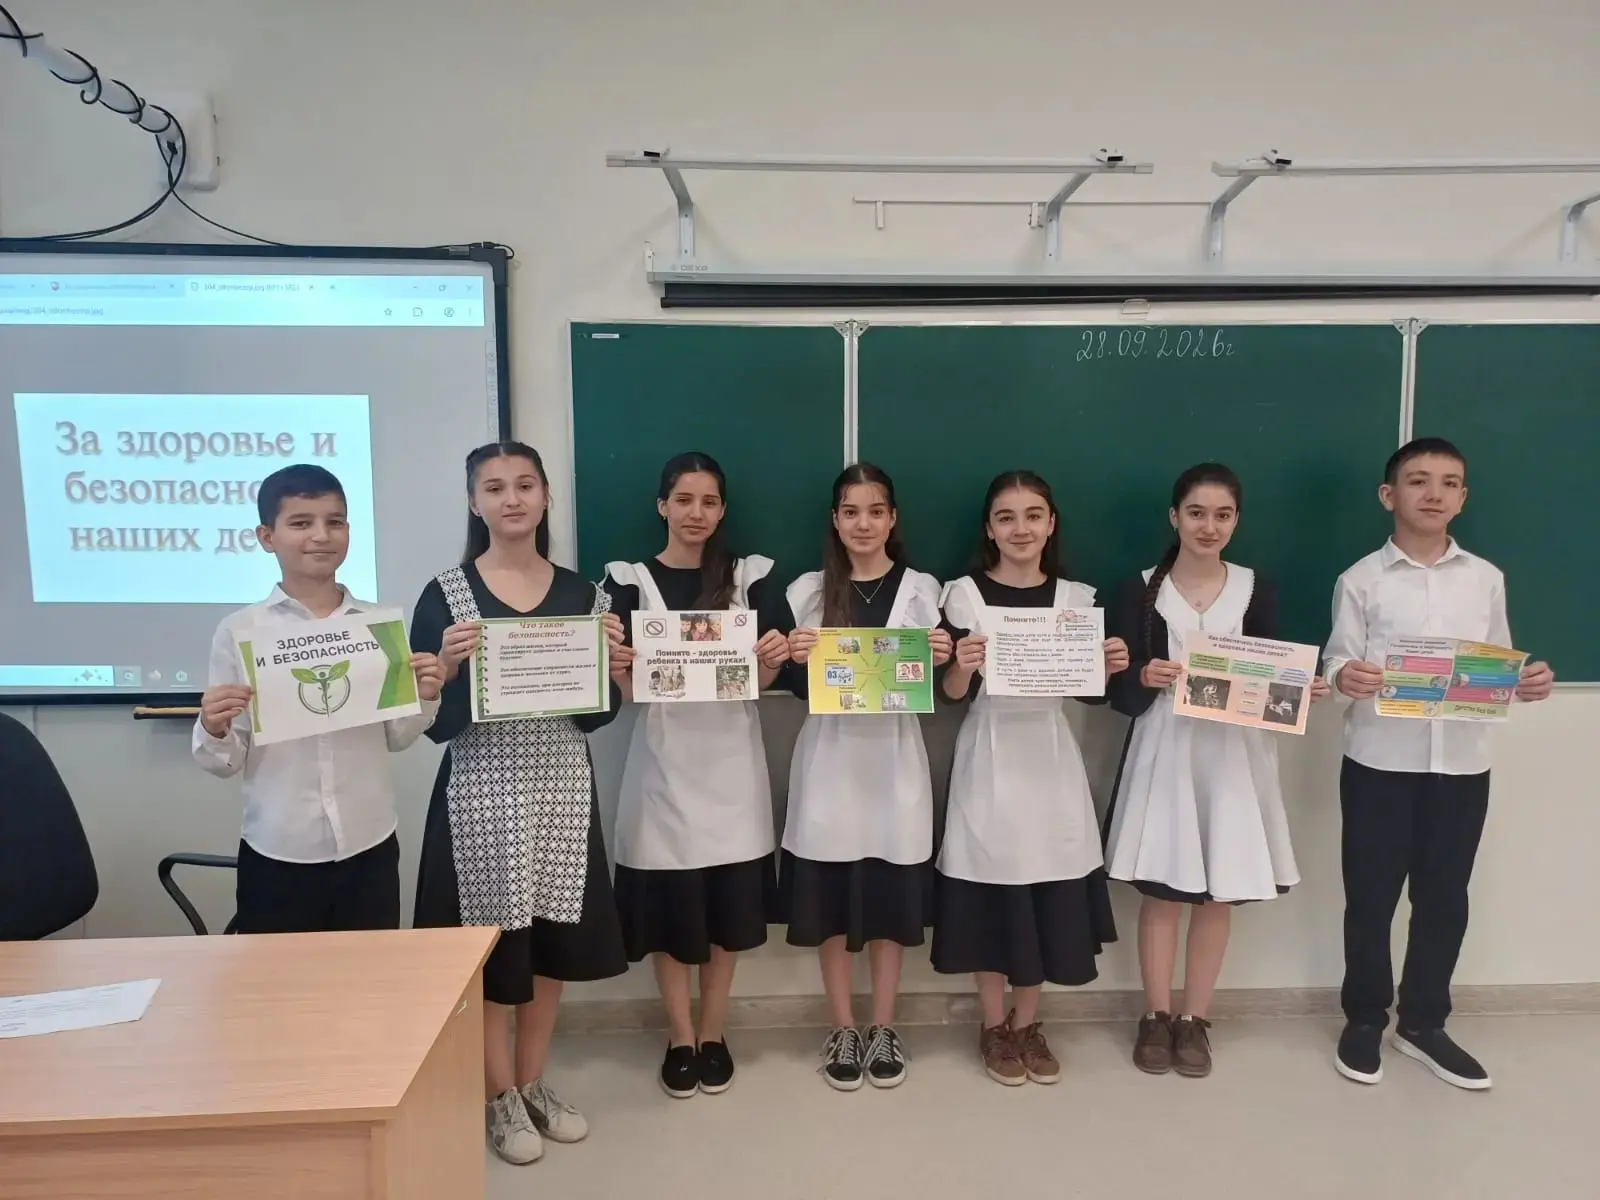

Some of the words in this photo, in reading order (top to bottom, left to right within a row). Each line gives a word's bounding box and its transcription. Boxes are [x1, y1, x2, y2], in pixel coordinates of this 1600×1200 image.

[55, 420, 101, 455] За
[117, 430, 295, 463] здоровье
[311, 431, 338, 457] и
[64, 470, 260, 504] безопасно
[68, 525, 202, 553] наших
[1003, 615, 1046, 624] Помните!!!
[519, 621, 538, 629] Что
[276, 630, 351, 650] ЗДОРОВЬЕ
[508, 630, 576, 640] безопасность?
[256, 657, 266, 668] И
[273, 641, 380, 665] БЕЗОПАСНОСТЬ
[656, 649, 690, 657] Помните
[698, 649, 738, 657] здоровье
[646, 657, 681, 666] ребенка
[718, 656, 746, 665] руках!
[827, 671, 837, 679] 03
